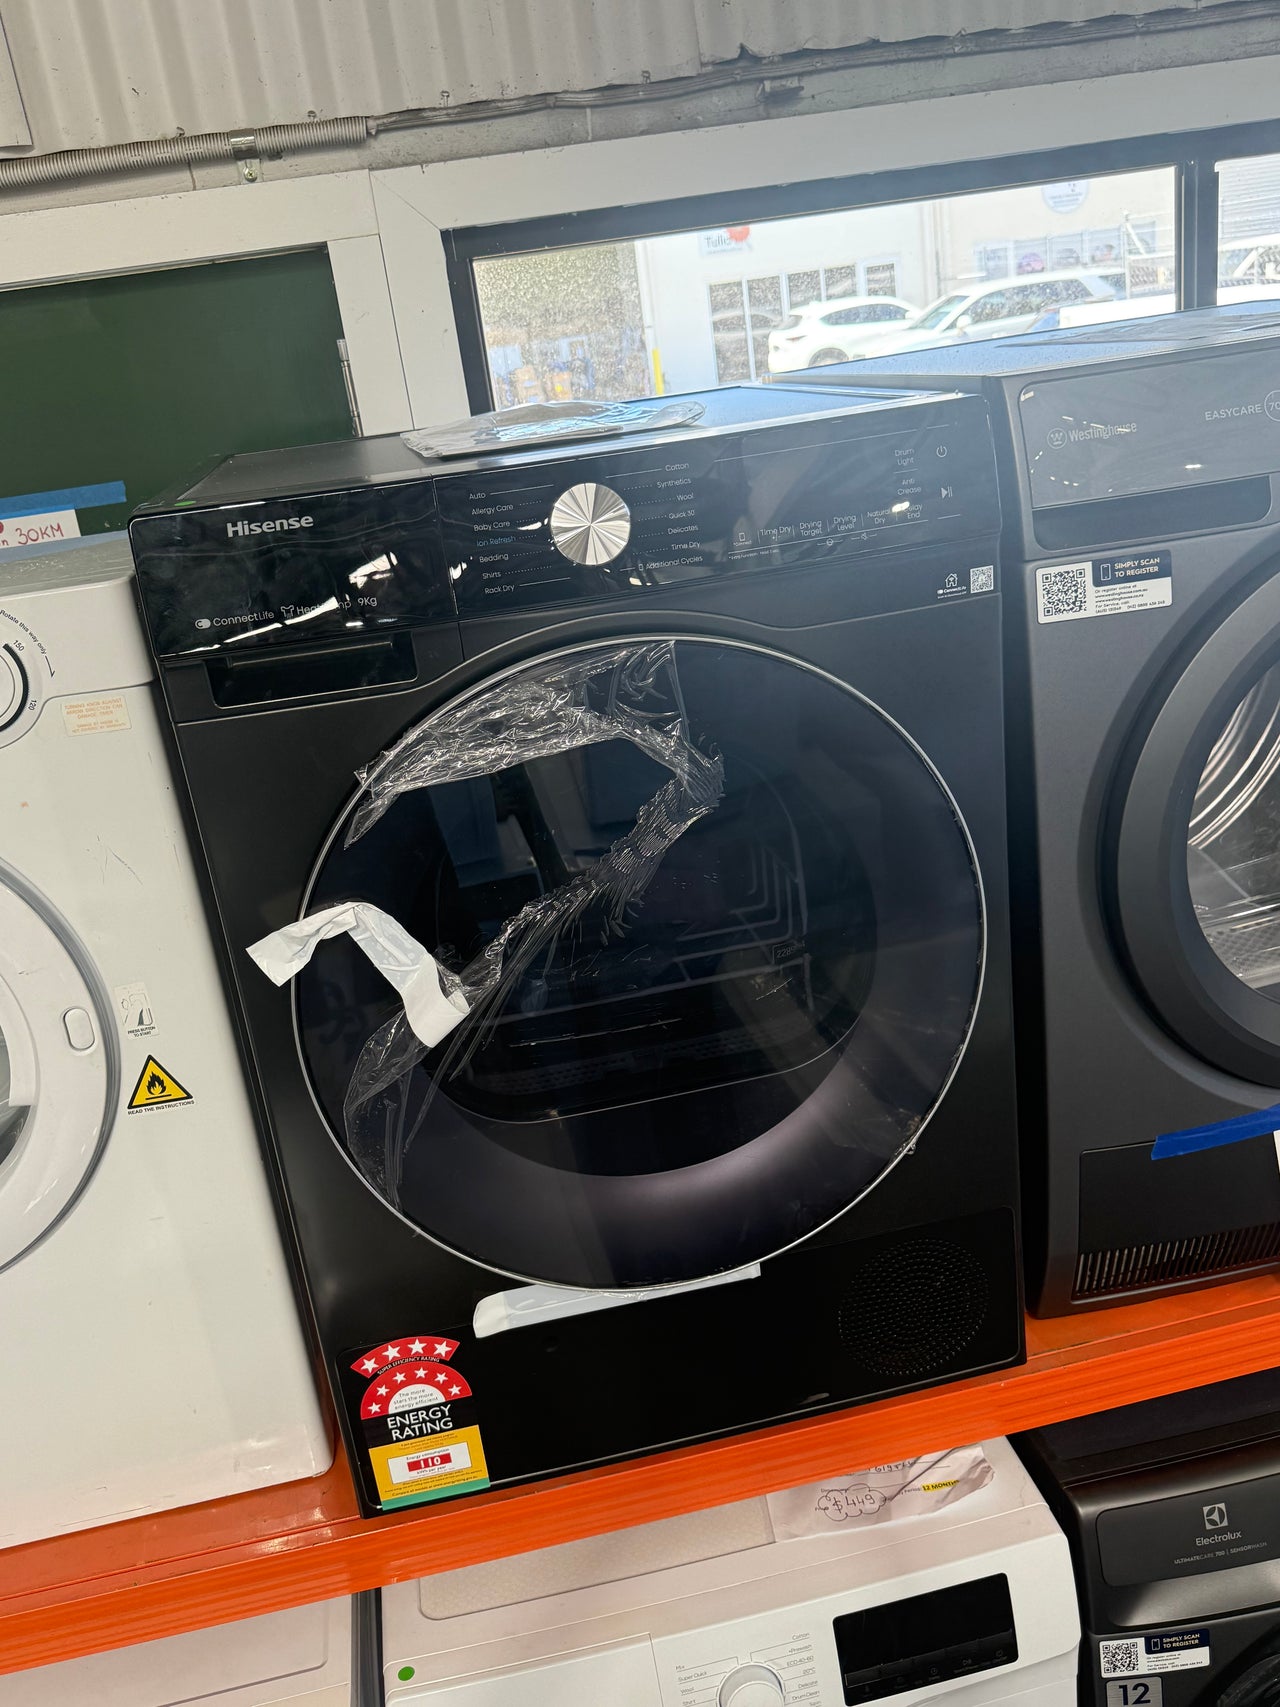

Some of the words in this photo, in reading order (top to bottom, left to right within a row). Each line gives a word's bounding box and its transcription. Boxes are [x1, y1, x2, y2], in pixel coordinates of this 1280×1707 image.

[1205, 404, 1263, 421] EASYCARE
[1069, 423, 1136, 441] Westinghouse
[895, 448, 914, 457] Drum
[897, 457, 914, 466] Light
[665, 463, 690, 472] Cotton
[657, 477, 691, 489] Synthetics
[469, 492, 486, 500] Auto
[897, 487, 921, 495] Crease
[676, 493, 694, 501] Wool
[472, 506, 495, 516] Allergy
[496, 504, 514, 512] Care
[867, 509, 890, 517] Natural
[904, 503, 922, 513] elay
[669, 511, 687, 520] Quick
[833, 515, 857, 524] Drying
[226, 515, 314, 538] Hisense
[474, 523, 492, 532] Baby
[493, 521, 510, 529] Care
[668, 525, 698, 535] Delicates
[779, 526, 792, 534] Dry
[800, 521, 822, 530] Drying
[837, 522, 855, 531] Level
[15, 522, 65, 545] 30KM
[801, 528, 822, 536] Target
[477, 539, 489, 547] Ion
[490, 535, 516, 545] Refresh
[689, 541, 701, 549] Dry
[479, 553, 509, 563] Bedding
[646, 558, 680, 570] Additional
[681, 555, 703, 564] Cycles
[1114, 560, 1139, 570] SIMPLY
[1140, 557, 1160, 566] SCAN
[482, 571, 502, 580] Shirts
[1126, 565, 1160, 576] REGISTER
[485, 586, 501, 594] Rack
[503, 584, 515, 593] Dry
[213, 610, 275, 627] ConnectLife
[357, 597, 378, 607] 9Kg
[0, 609, 19, 624] Rotate
[19, 622, 29, 633] this
[28, 631, 39, 643] way
[37, 642, 47, 655] only
[13, 640, 25, 652] 150
[28, 699, 37, 711] 120
[127, 1108, 143, 1116] READ
[156, 1099, 195, 1111] INSTRUCTIONS
[377, 1364, 393, 1375] SUPER
[392, 1356, 420, 1367] EFFICIENCY
[415, 1397, 438, 1405] efficient
[386, 1404, 452, 1430] ENERGY
[391, 1417, 453, 1441] RATING
[420, 1456, 441, 1469] 110
[1195, 1531, 1242, 1546] Electrolux
[1174, 1552, 1214, 1565] ULTIMATECARE
[792, 1632, 810, 1640] Cotton
[1172, 1638, 1199, 1648] REGISTER
[1118, 1681, 1152, 1707] 12
